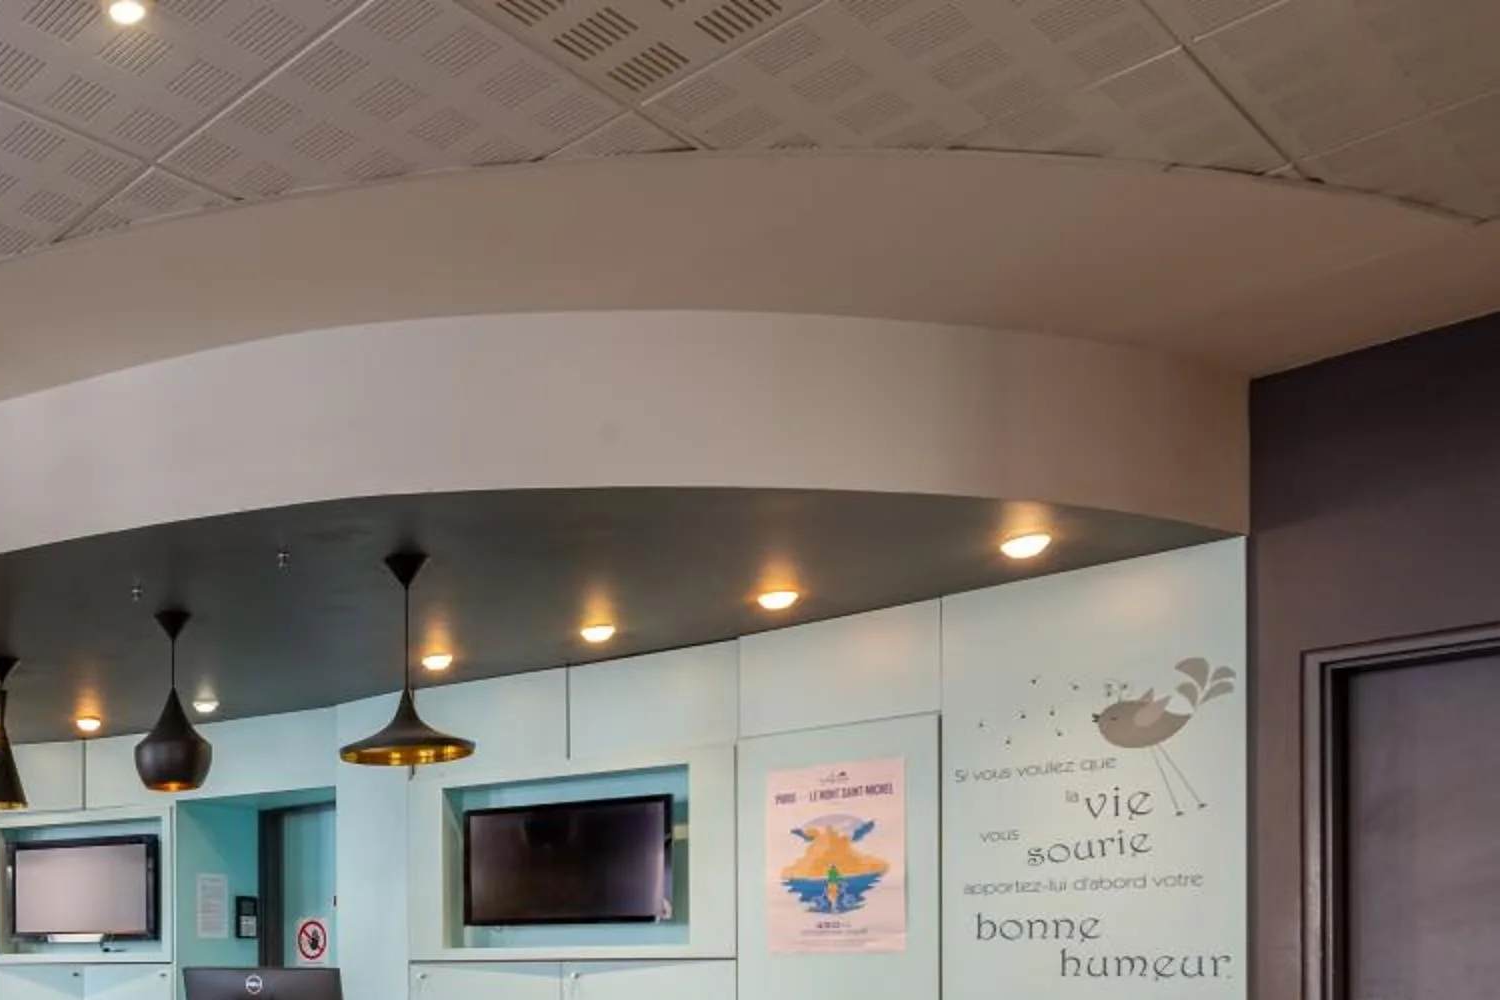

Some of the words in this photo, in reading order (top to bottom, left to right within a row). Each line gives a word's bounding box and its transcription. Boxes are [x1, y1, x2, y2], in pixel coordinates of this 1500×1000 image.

[972, 767, 1012, 782] vous
[1017, 759, 1076, 778] voulez
[1064, 789, 1080, 804] la
[1084, 786, 1155, 821] vie
[978, 829, 1021, 844] vous
[1026, 829, 1154, 867] sourie
[962, 879, 1067, 897] apportez-lui
[1073, 874, 1148, 893] d'abord
[1151, 872, 1205, 889] votre
[975, 912, 1102, 943] bonne
